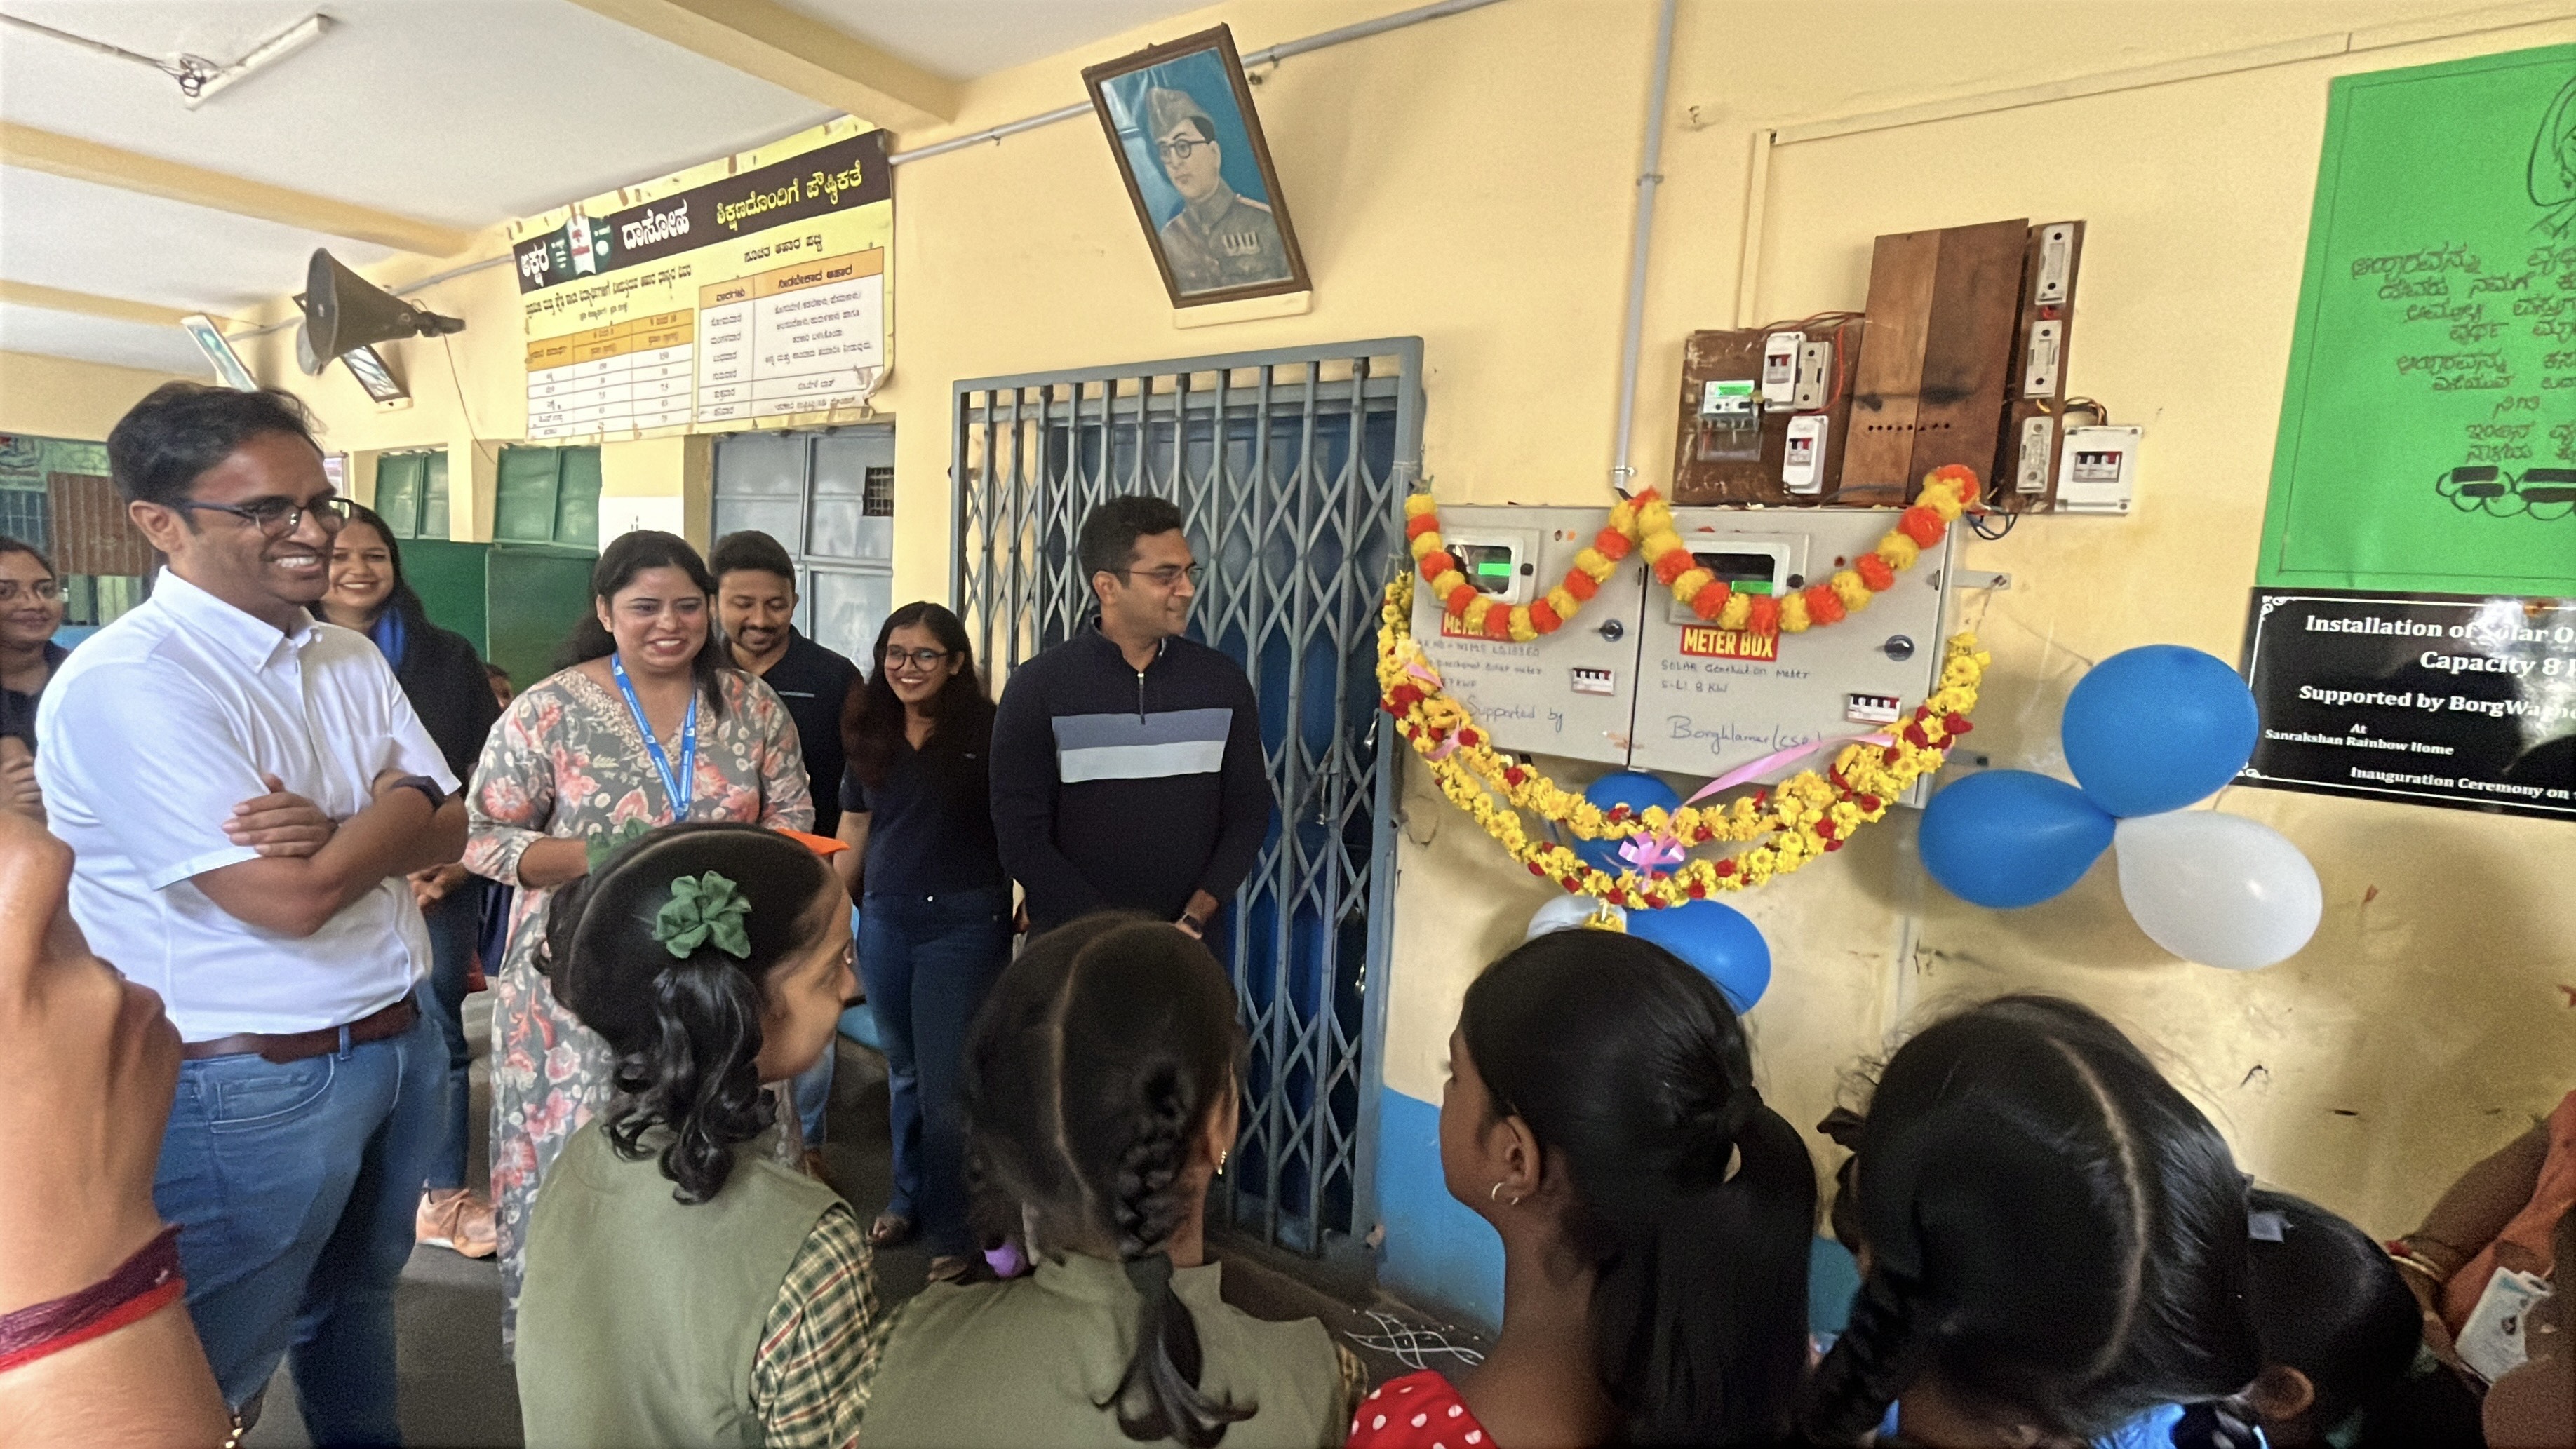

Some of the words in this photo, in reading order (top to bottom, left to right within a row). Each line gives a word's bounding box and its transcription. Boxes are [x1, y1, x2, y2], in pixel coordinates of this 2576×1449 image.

[717, 178, 800, 231] ಶಿಕ್ಷಣದೊಂದಿಗೆ
[622, 198, 690, 250] ದಾಸೋಹ
[1684, 628, 1736, 656] METER
[1740, 633, 1773, 658] BOX
[2305, 615, 2442, 638] Installation
[2449, 622, 2475, 638] of
[2478, 623, 2549, 642] olar
[2554, 626, 2576, 644] O
[1661, 660, 1698, 671] SOLAR
[2420, 651, 2537, 678] Capacity
[2542, 657, 2561, 675] 8
[2299, 685, 2411, 708] Supported
[2417, 692, 2446, 712] by
[1468, 695, 1535, 722] Supported
[1548, 707, 1563, 733] by
[2350, 723, 2367, 734] At
[2265, 729, 2343, 746] Sanrakshan
[2346, 736, 2408, 753] Rainbow
[2411, 741, 2454, 756] Home
[2350, 767, 2454, 788] Inauguration
[2458, 778, 2544, 798] Ceremony
[2547, 788, 2570, 800] on
